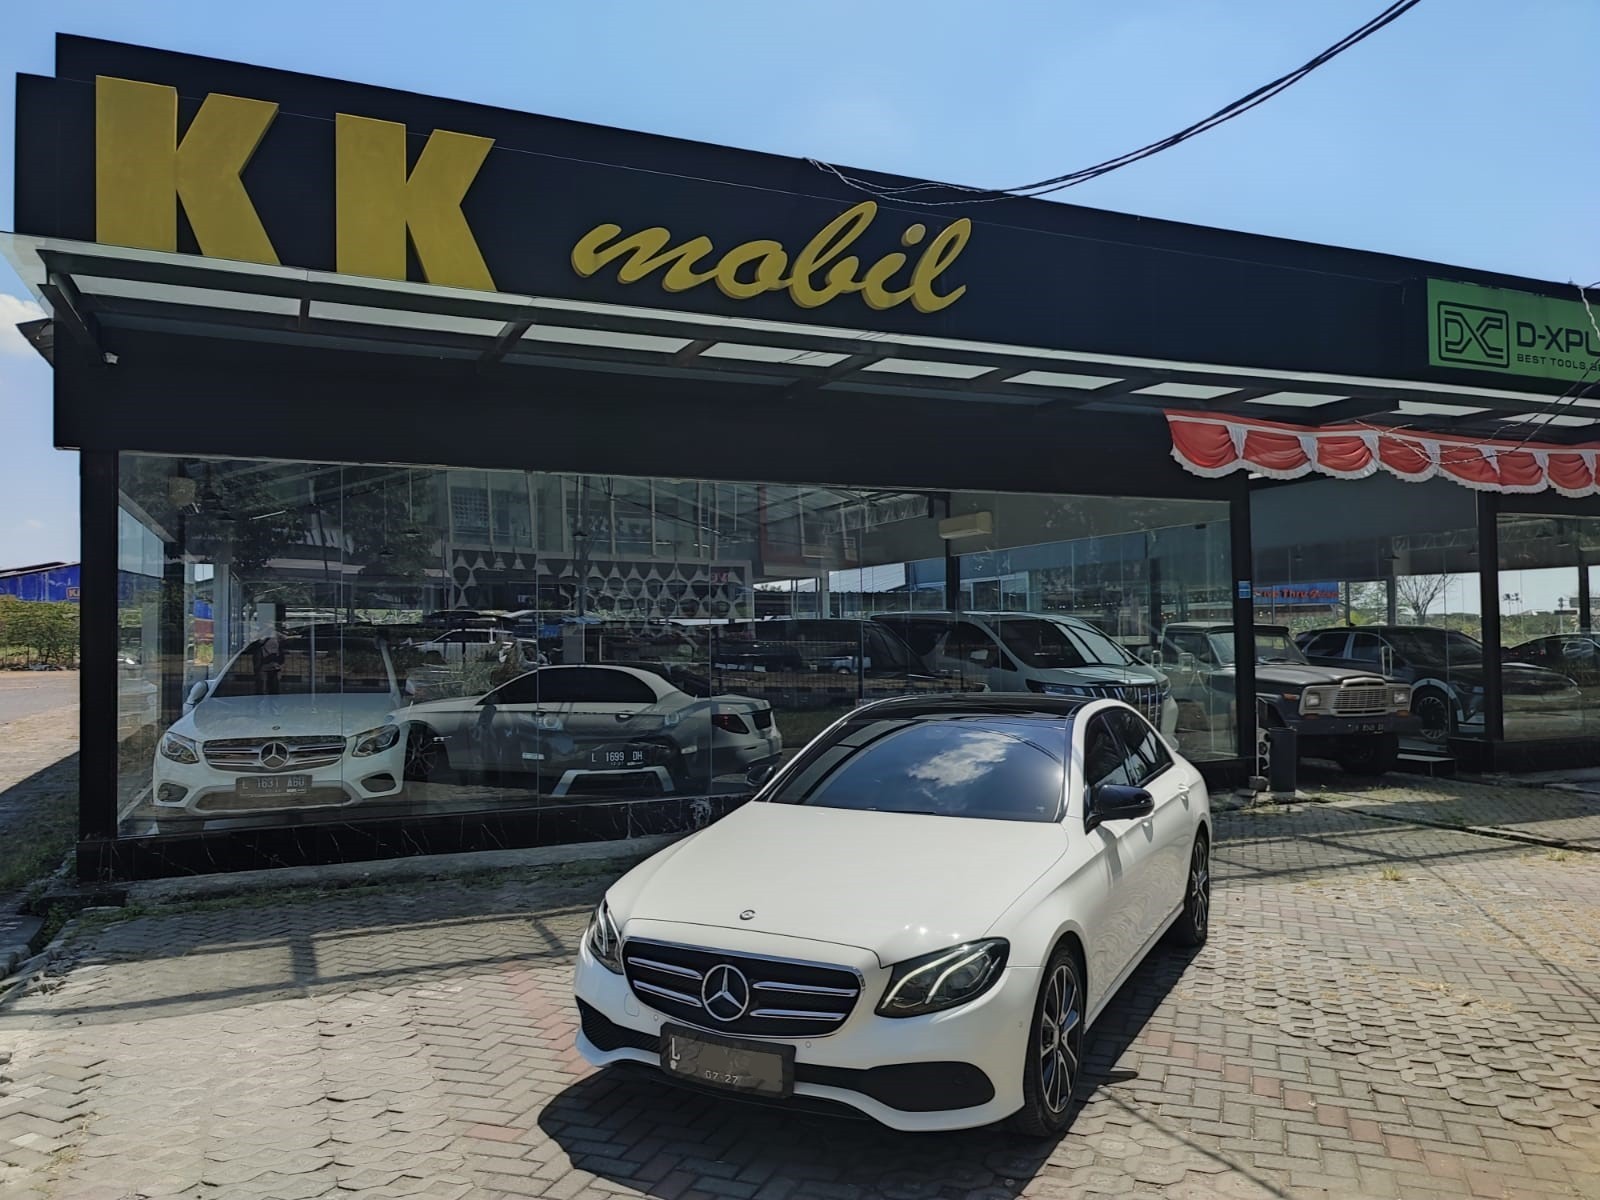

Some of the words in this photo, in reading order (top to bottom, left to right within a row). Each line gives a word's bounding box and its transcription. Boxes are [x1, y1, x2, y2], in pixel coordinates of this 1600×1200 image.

[571, 200, 972, 314] mobil
[1517, 353, 1546, 365] BEST
[592, 753, 597, 762] L
[606, 752, 624, 762] 1699
[242, 780, 248, 789] L
[256, 776, 279, 788] 1631
